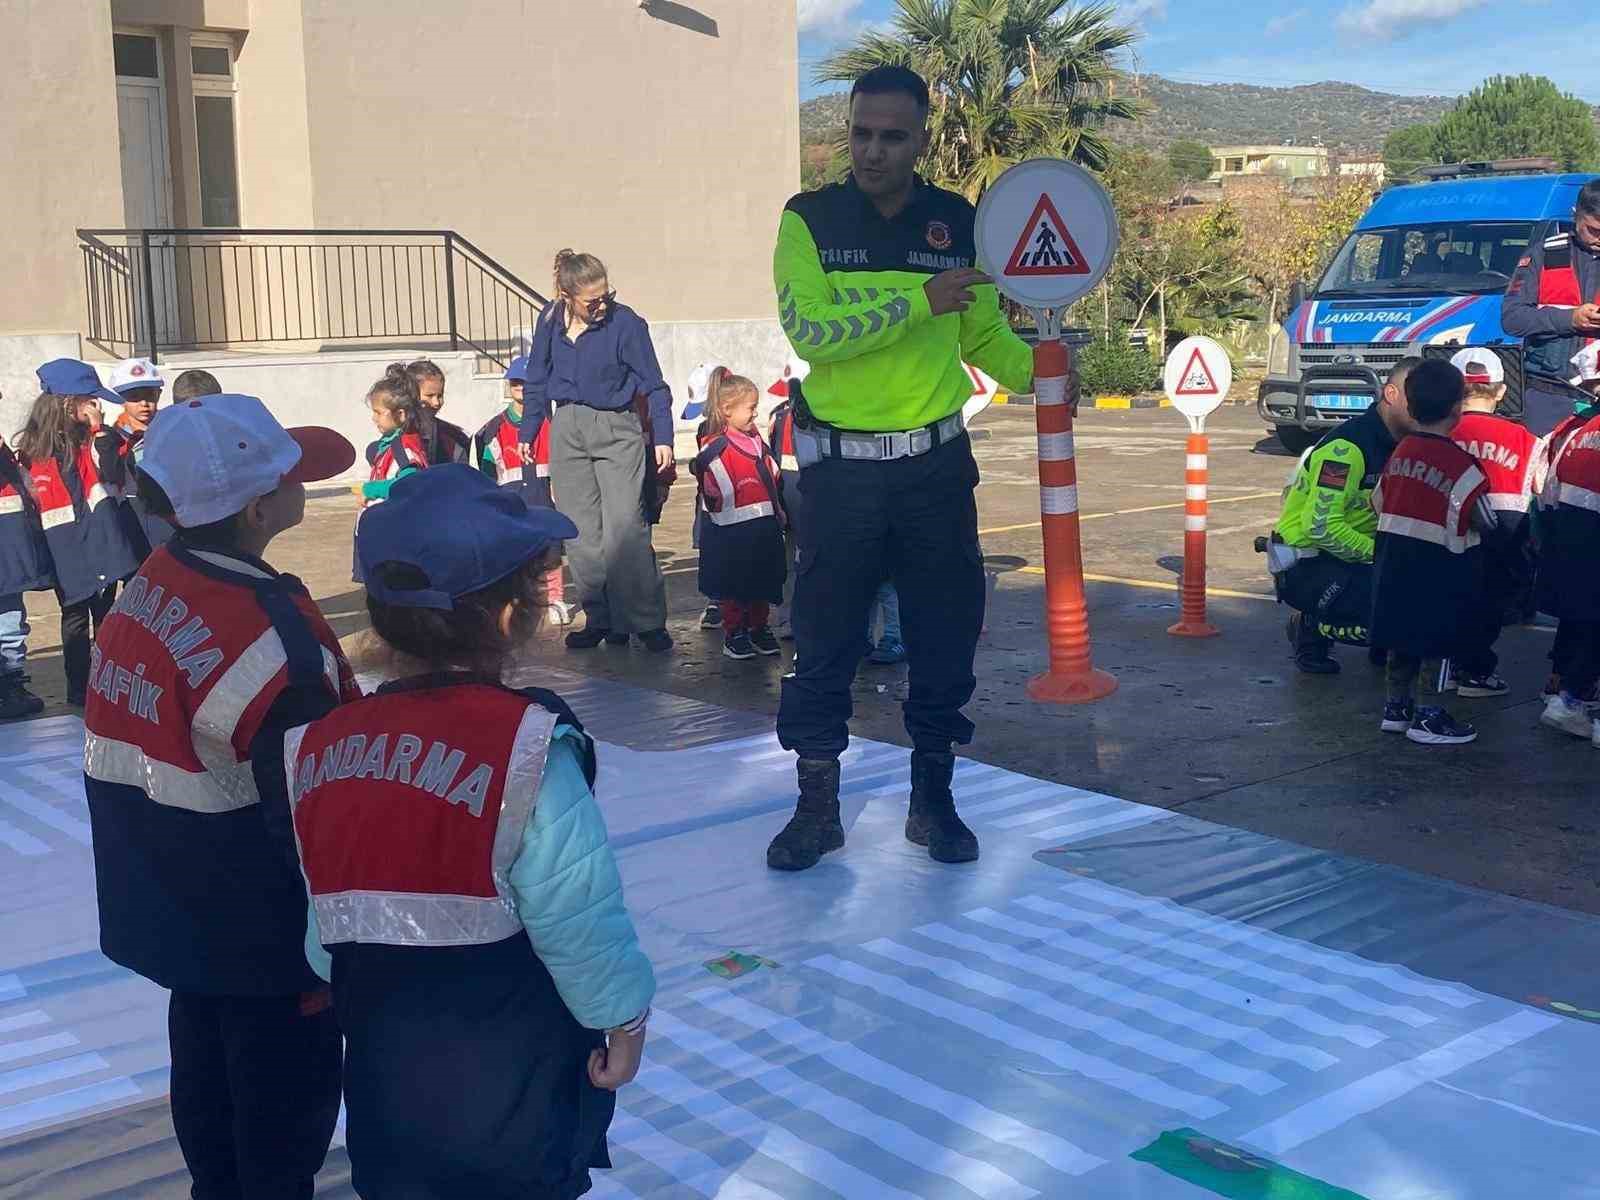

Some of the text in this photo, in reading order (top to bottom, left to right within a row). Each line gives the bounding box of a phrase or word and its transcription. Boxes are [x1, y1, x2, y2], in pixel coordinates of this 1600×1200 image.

[1319, 311, 1412, 325] JANDARMA
[1389, 457, 1453, 493] DARMA
[89, 643, 164, 725] RAFİK
[293, 733, 494, 819] ANDARMA
